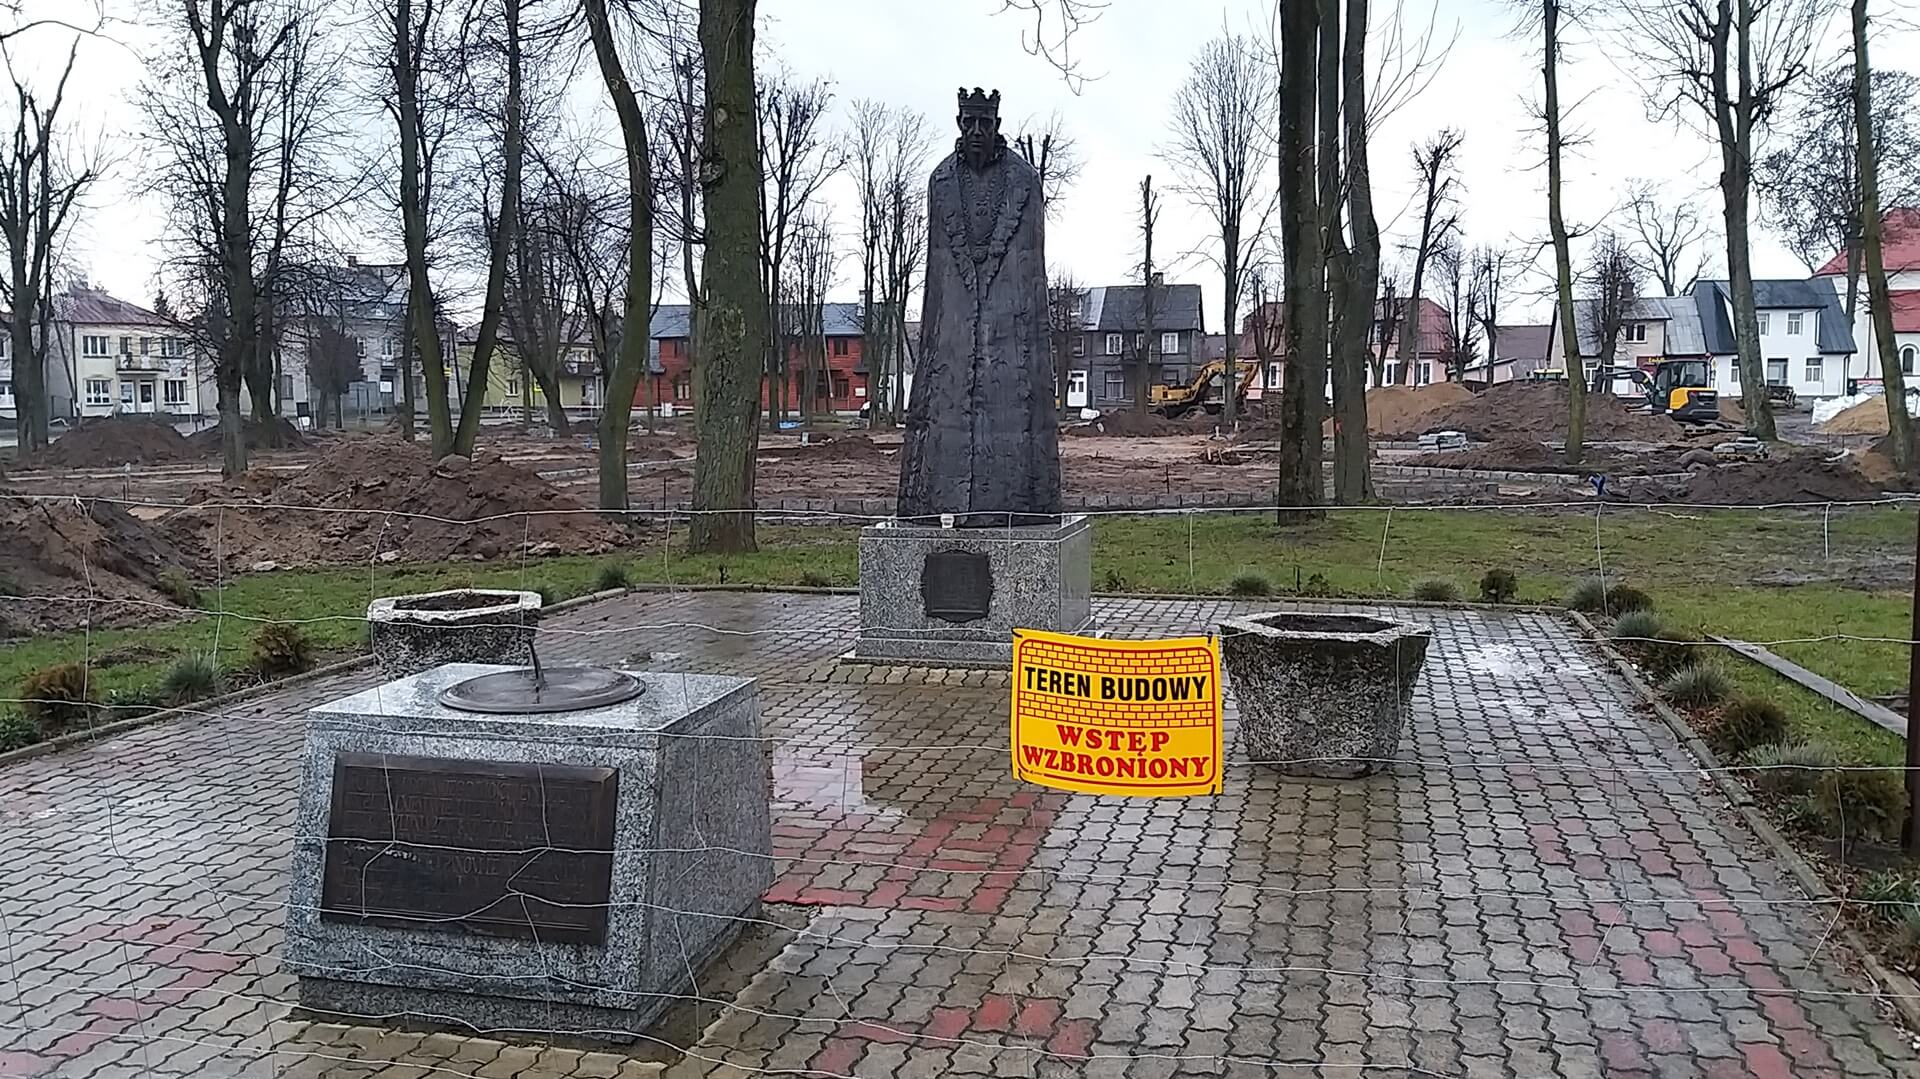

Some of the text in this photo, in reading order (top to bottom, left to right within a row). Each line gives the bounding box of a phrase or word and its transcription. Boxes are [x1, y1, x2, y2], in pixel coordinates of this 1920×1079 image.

[1024, 666, 1207, 701] TEREN BUDOWY
[1056, 724, 1170, 756] WSTĘP
[1021, 745, 1210, 778] WZBRONIONY
